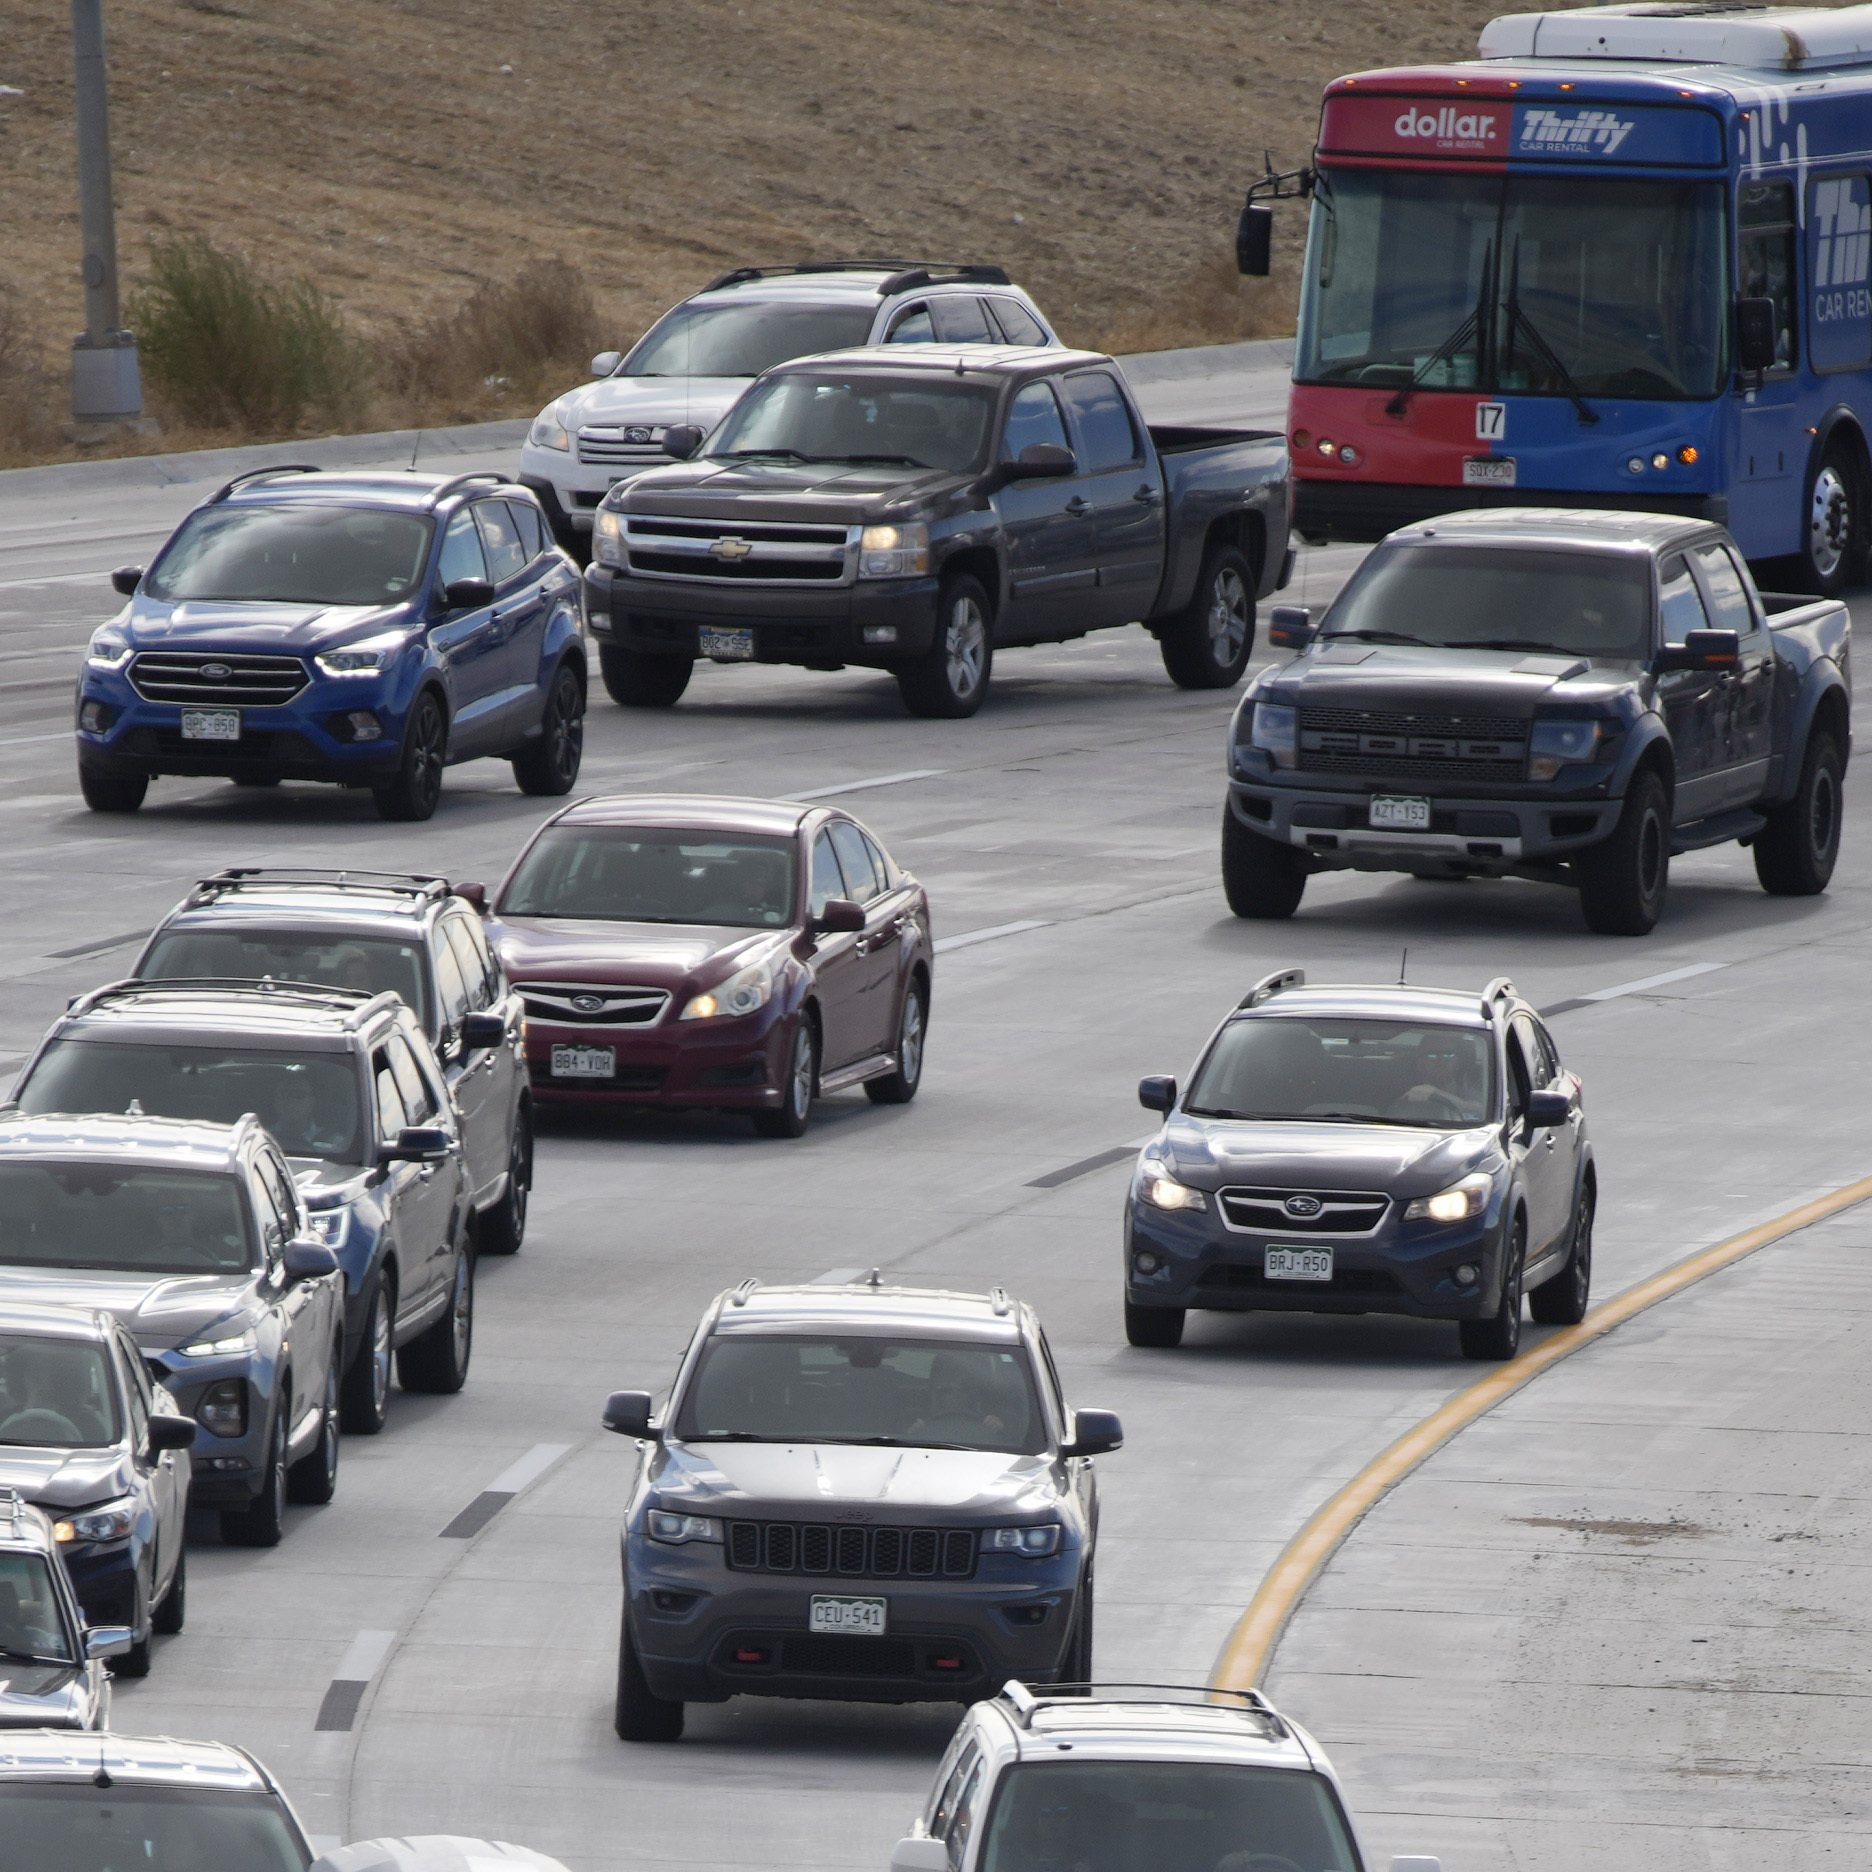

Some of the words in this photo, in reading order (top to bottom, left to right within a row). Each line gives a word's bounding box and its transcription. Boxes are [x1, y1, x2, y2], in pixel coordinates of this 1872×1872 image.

[1520, 109, 1634, 154] Thrifty
[1519, 142, 1545, 152] CAR
[1548, 143, 1590, 153] RENTAL
[1816, 290, 1844, 322] CAR
[1479, 405, 1502, 434] 17
